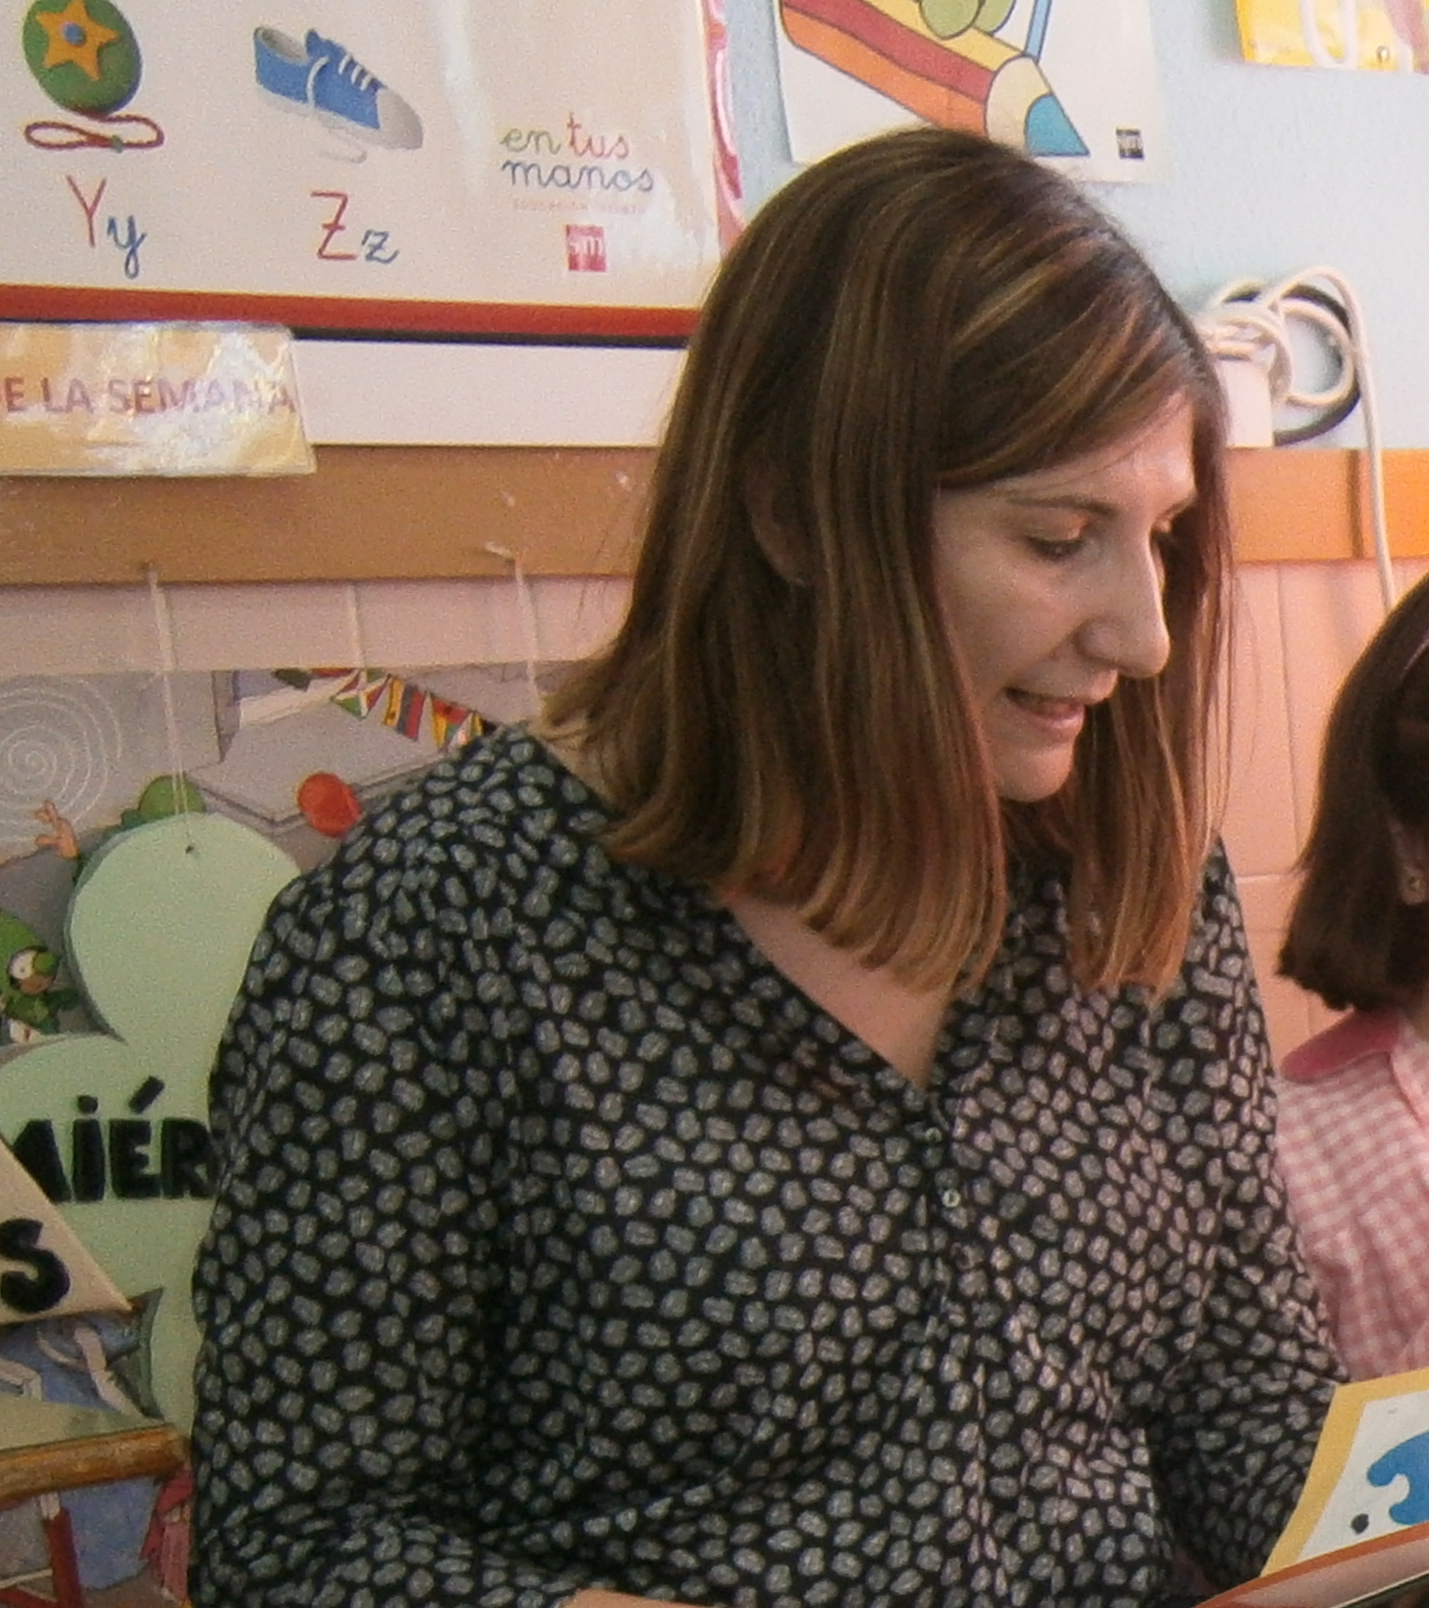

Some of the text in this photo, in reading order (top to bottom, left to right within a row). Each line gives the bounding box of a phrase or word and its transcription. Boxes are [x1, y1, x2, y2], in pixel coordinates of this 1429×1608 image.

[500, 112, 630, 160] en tus
[501, 160, 654, 192] manos
[40, 377, 94, 414] LA
